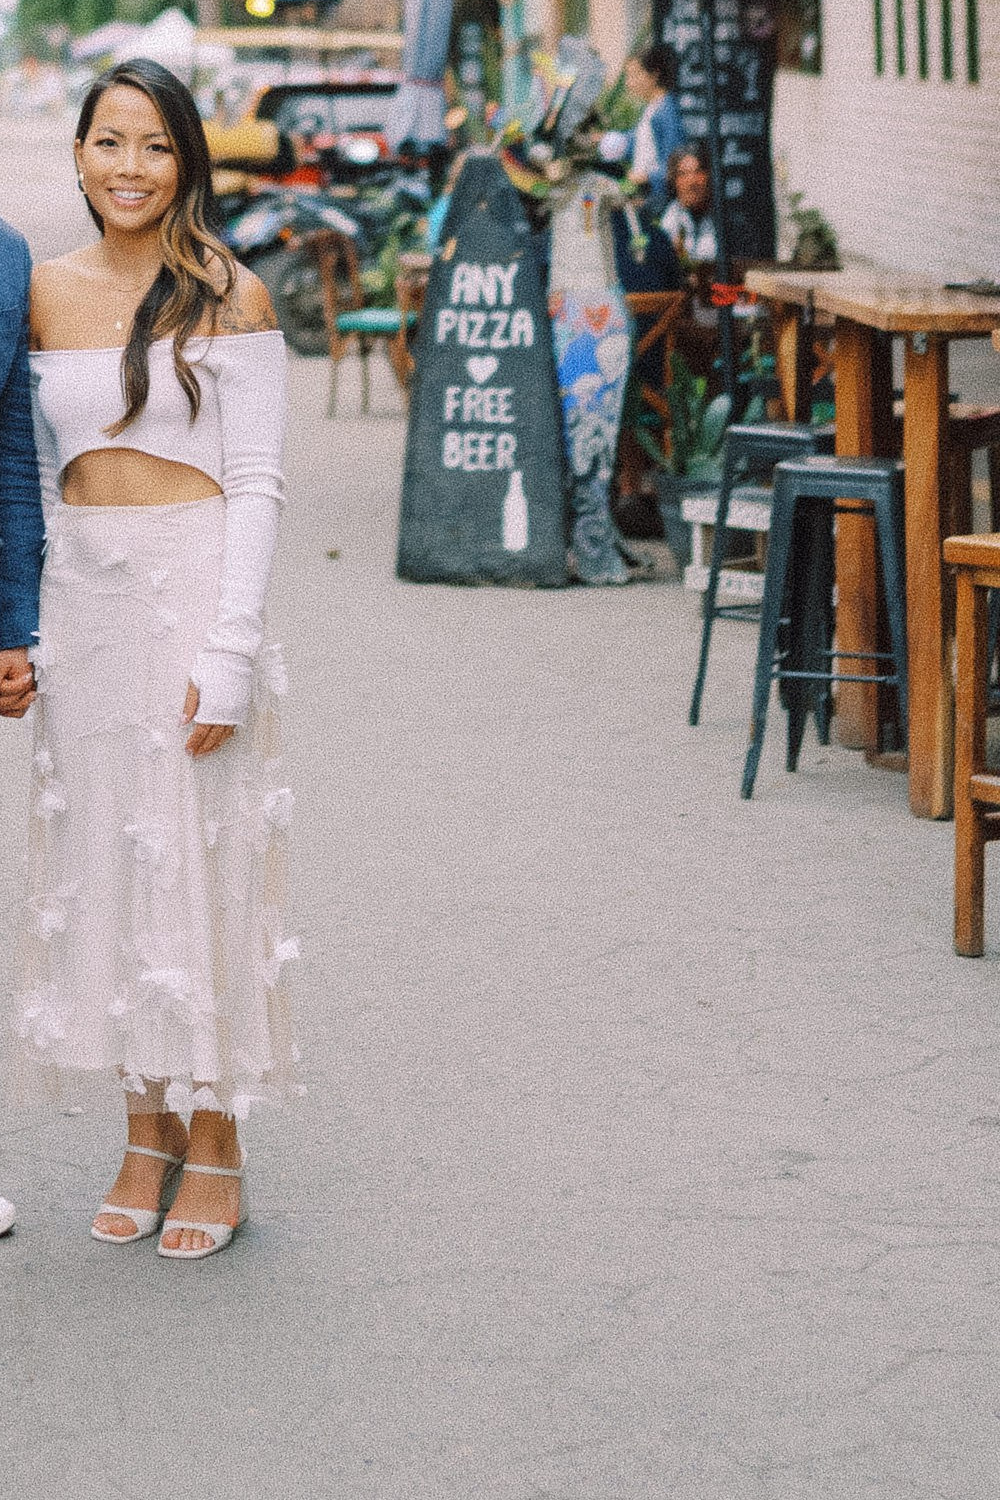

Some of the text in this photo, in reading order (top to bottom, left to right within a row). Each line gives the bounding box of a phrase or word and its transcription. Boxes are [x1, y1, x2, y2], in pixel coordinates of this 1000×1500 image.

[450, 262, 519, 305] ANY
[436, 308, 534, 349] PIZZA
[444, 386, 515, 424] FREE
[442, 431, 516, 472] BEER
